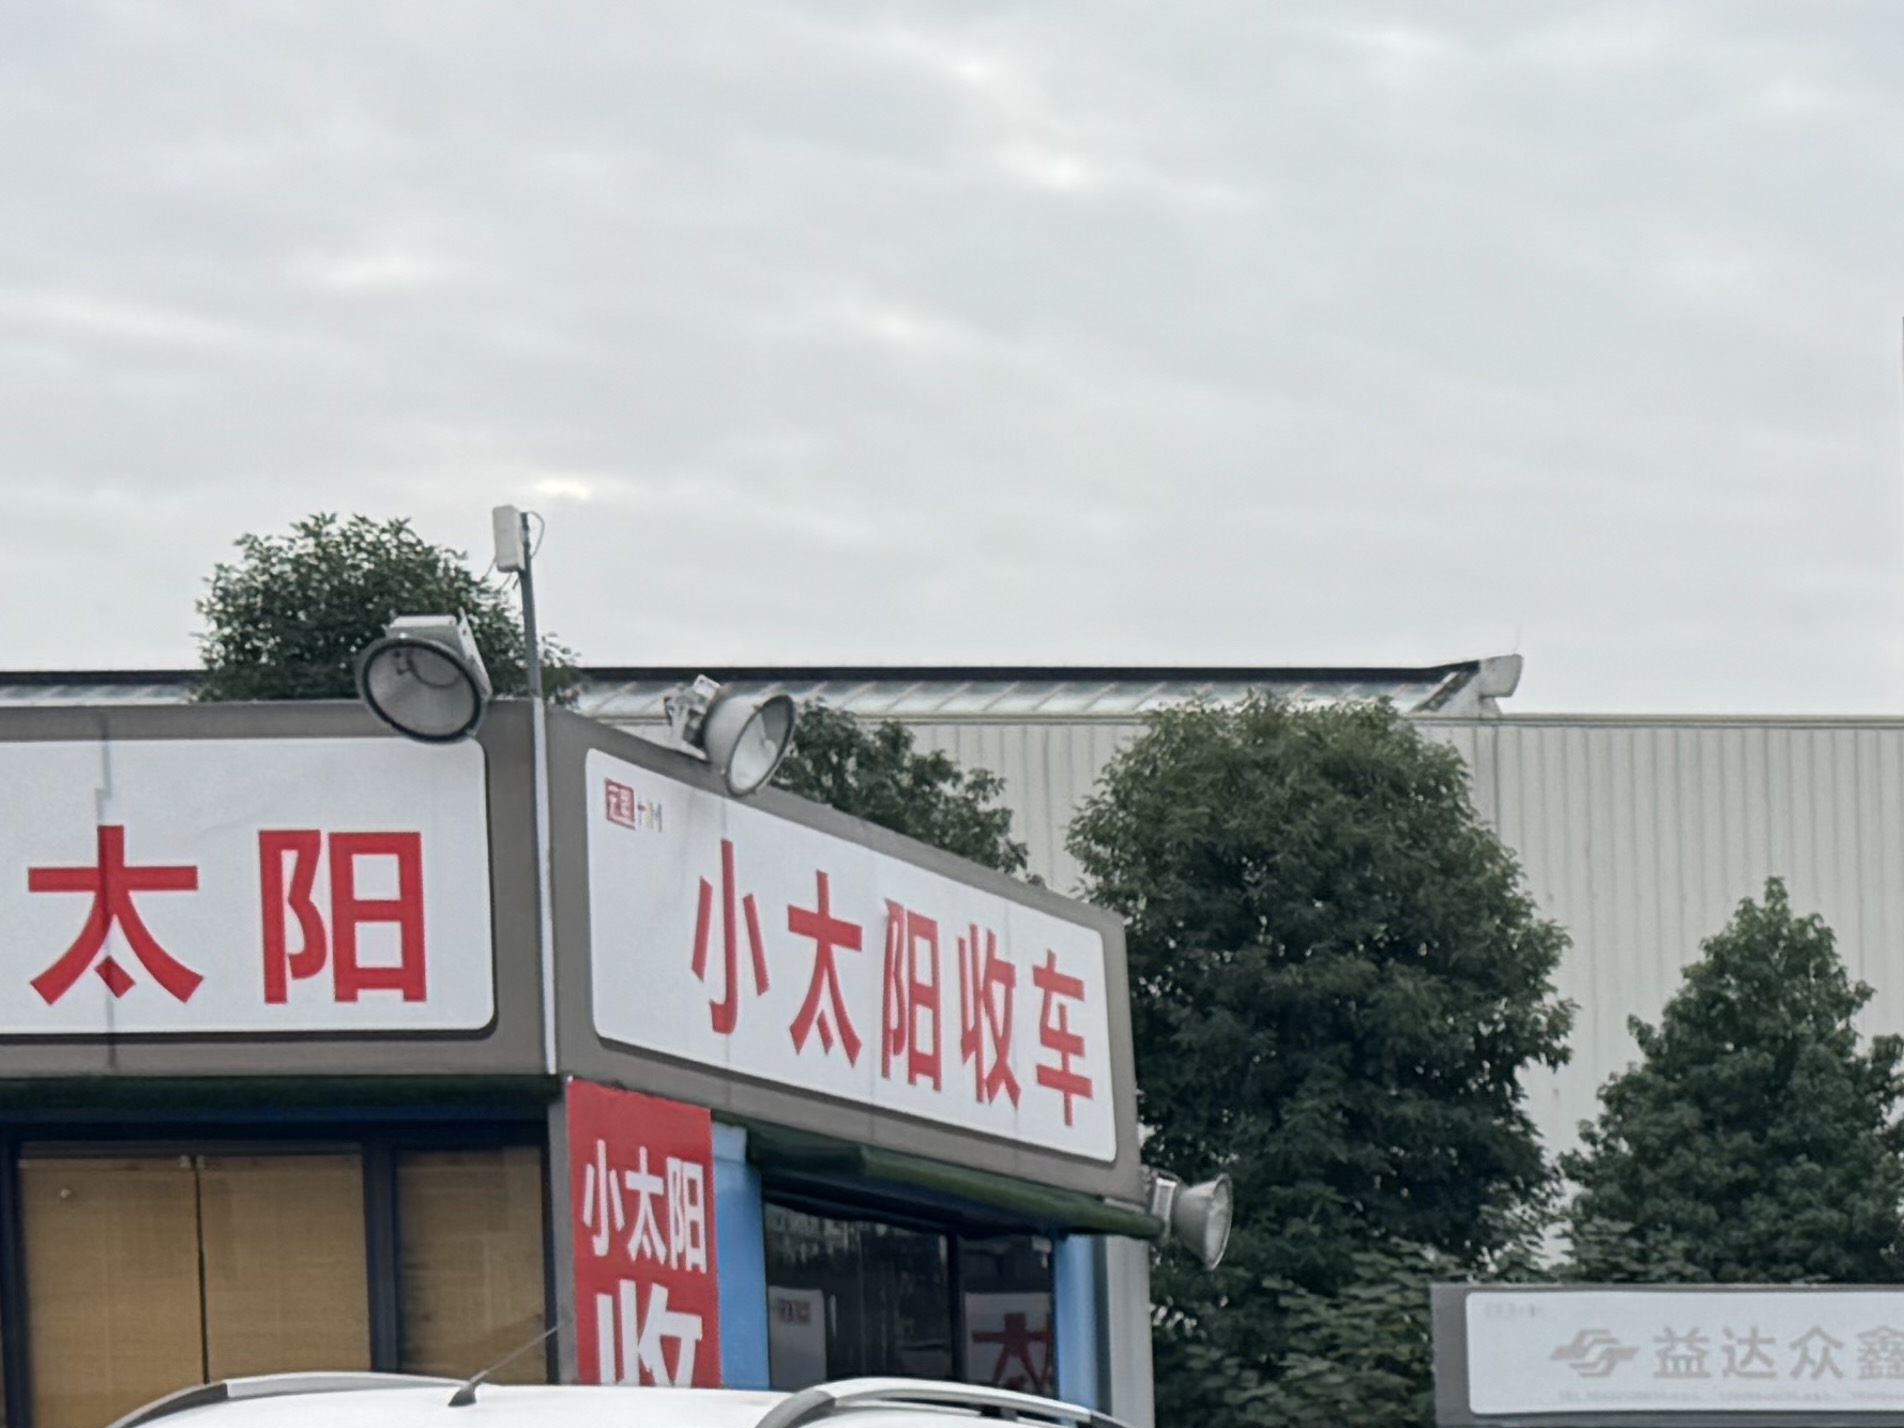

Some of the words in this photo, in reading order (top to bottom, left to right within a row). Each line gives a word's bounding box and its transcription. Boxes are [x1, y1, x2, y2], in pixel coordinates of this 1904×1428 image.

[27, 825, 428, 1005] 太阳
[691, 837, 1094, 1128] 小太阳收车
[583, 1138, 708, 1275] 小太阳
